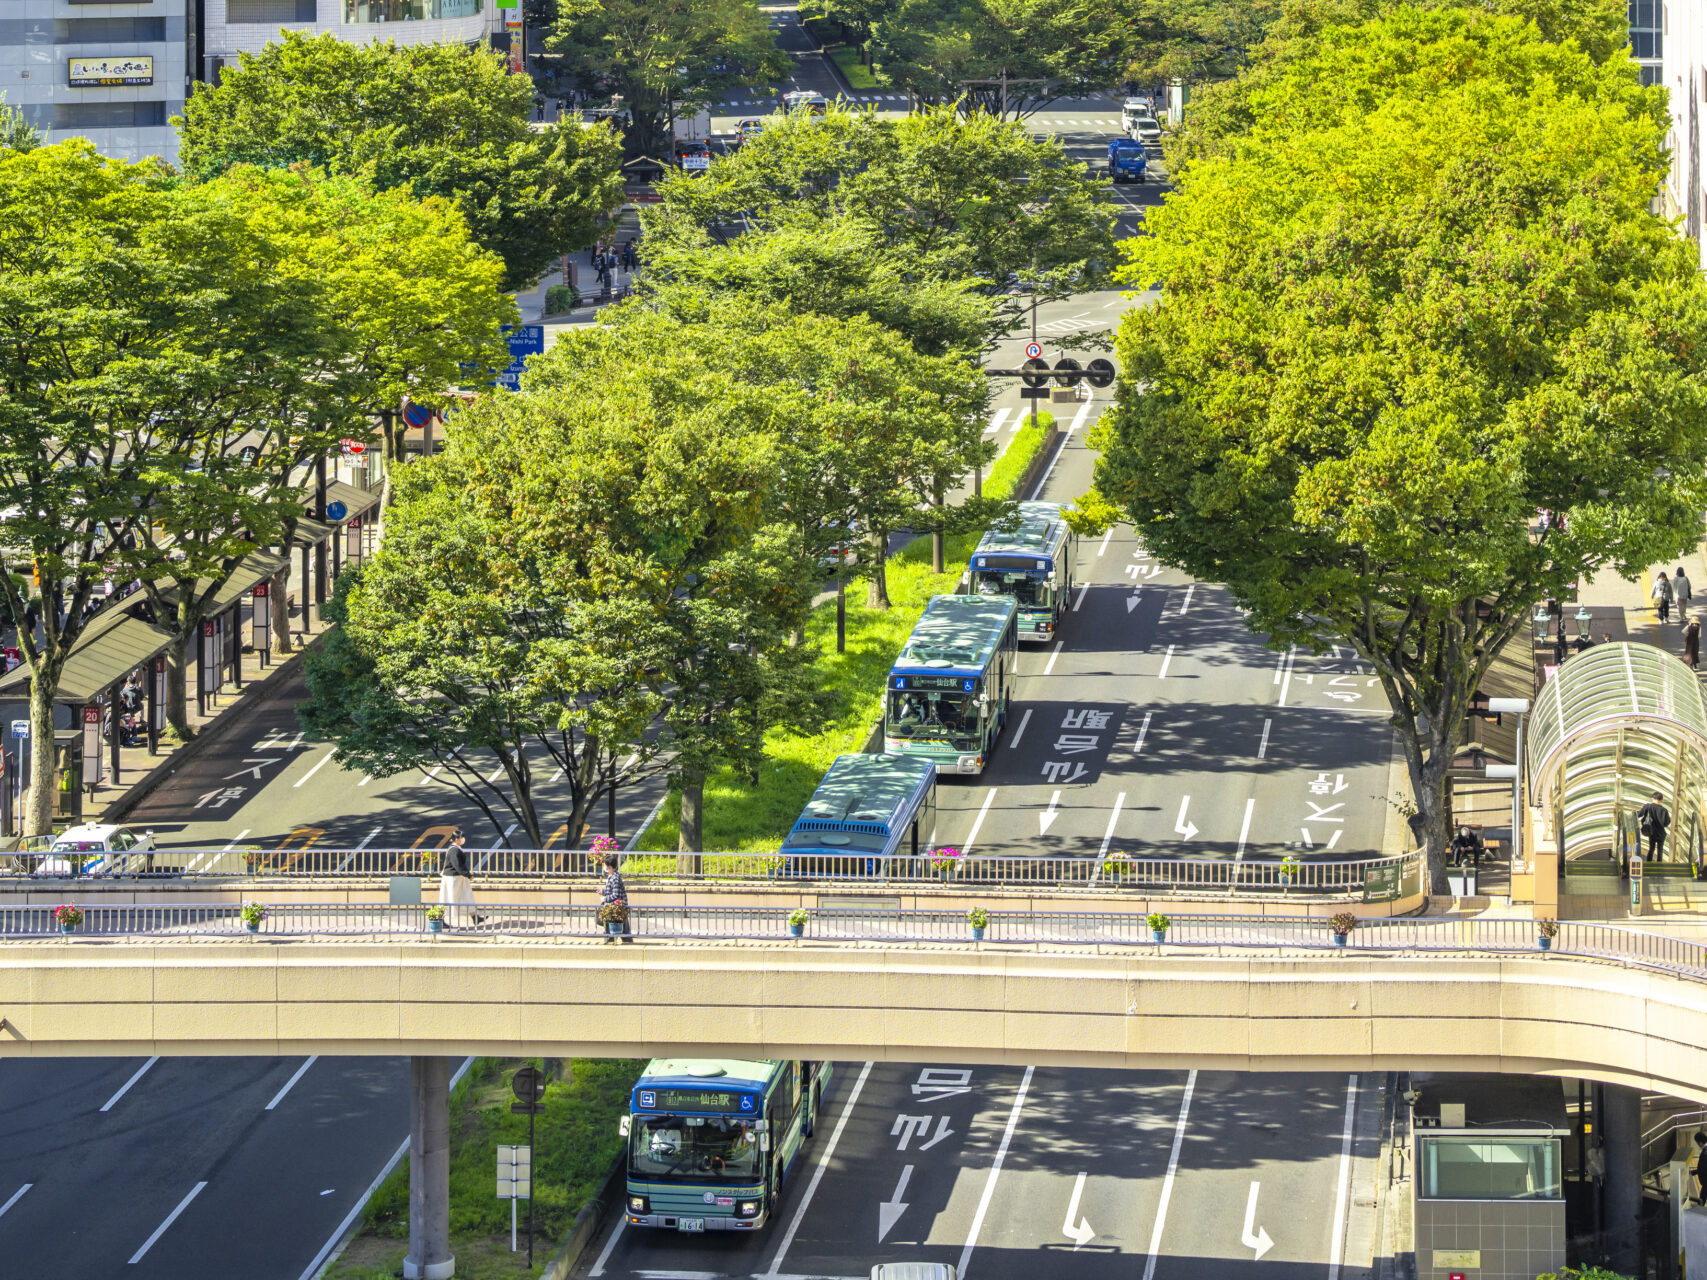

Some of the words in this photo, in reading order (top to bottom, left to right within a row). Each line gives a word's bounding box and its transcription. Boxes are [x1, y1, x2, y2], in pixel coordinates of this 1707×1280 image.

[350, 519, 359, 527] 24
[256, 587, 265, 596] 23
[936, 677, 958, 687] 仙台駅
[86, 712, 98, 722] 20
[1040, 708, 1114, 783] 仙台駅
[1284, 773, 1349, 849] バス停
[700, 1092, 730, 1106] 仙台駅
